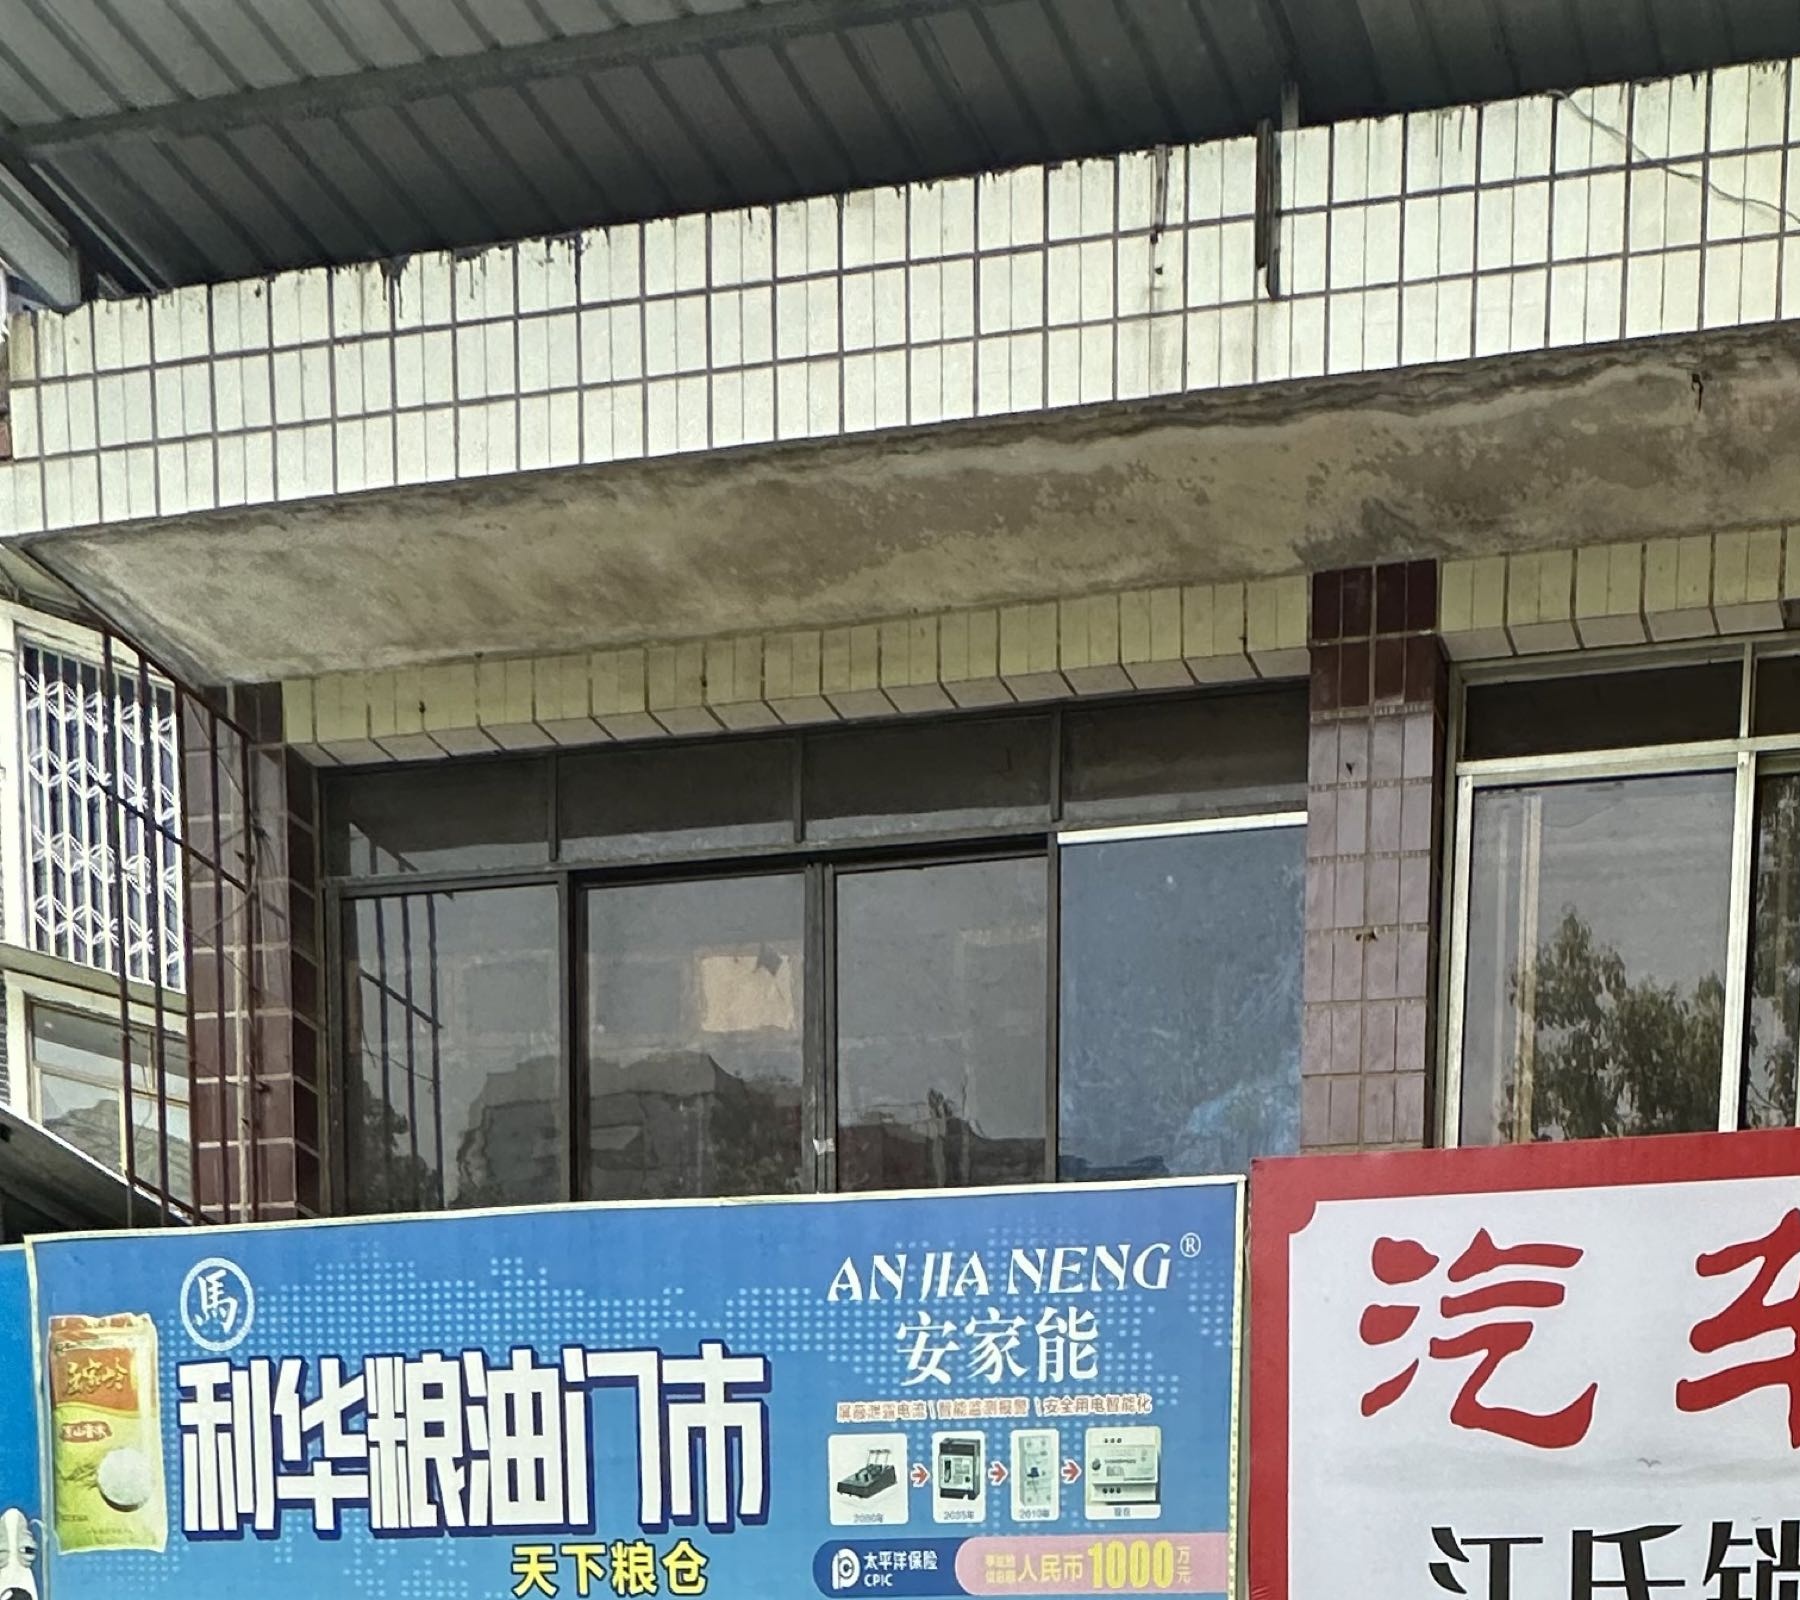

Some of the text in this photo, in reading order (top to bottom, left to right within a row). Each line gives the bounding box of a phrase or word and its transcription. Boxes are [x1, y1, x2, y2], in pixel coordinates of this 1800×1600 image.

[1006, 1242, 1172, 1295] NENG
[194, 1268, 239, 1333] 馬
[895, 1306, 1100, 1386] 安家能
[177, 1343, 766, 1532] 利华粮油门市
[511, 1538, 710, 1598] 天下粮仓
[864, 1549, 938, 1571] 太平洋保险
[864, 1573, 893, 1588] CPIC
[1018, 1540, 1174, 1590] 人民币 1000
